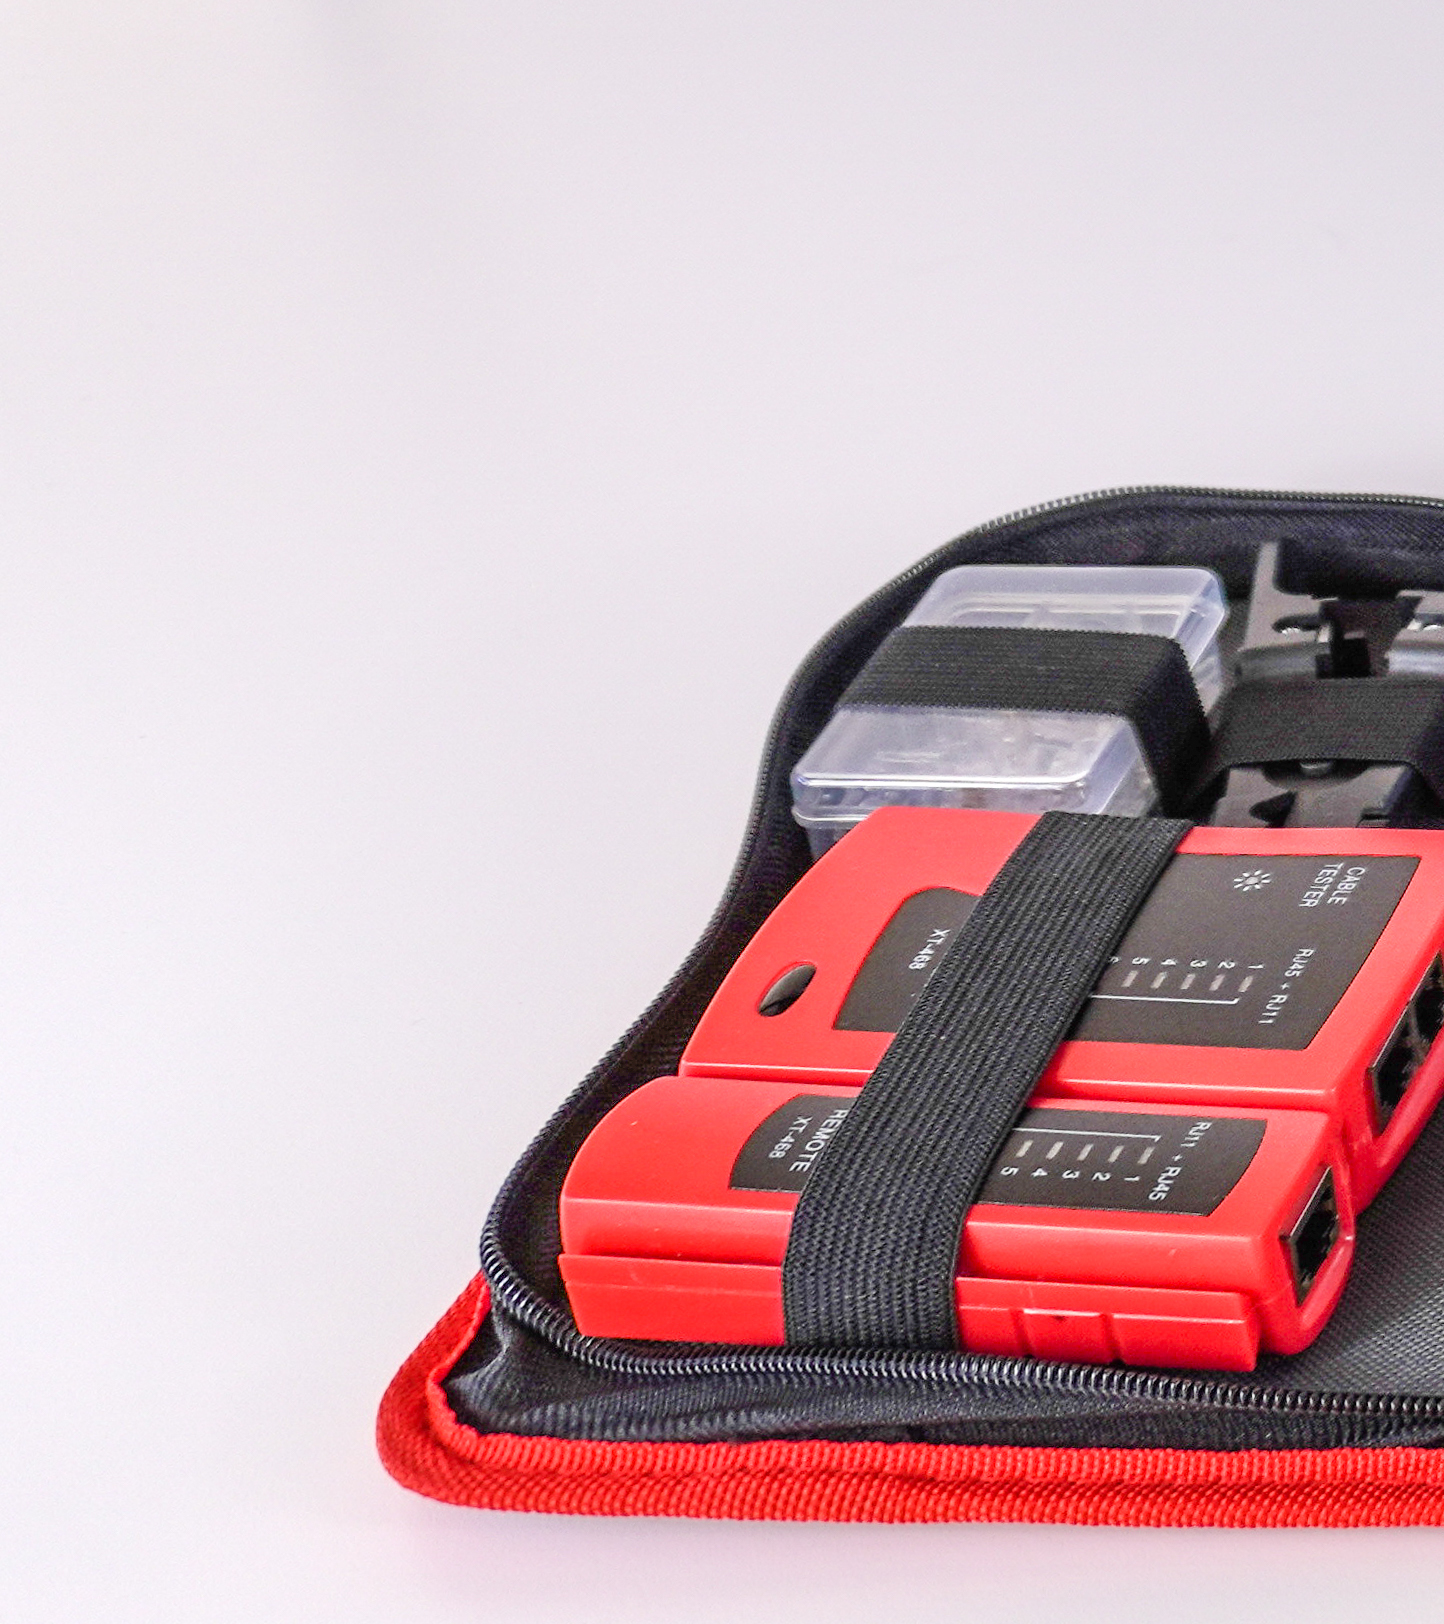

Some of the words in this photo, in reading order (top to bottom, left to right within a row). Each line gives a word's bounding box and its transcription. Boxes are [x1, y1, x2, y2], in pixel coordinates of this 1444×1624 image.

[1299, 862, 1345, 908] TESTER
[1327, 866, 1366, 906] CABLE
[908, 928, 950, 970] XT-468
[1132, 956, 1150, 966] 5
[1161, 958, 1177, 967] 4
[1190, 959, 1208, 969] 3
[1218, 960, 1236, 970] 2
[1284, 947, 1315, 978] RJ45
[1257, 994, 1289, 1025] RJ11
[768, 1115, 813, 1159] XT-468
[789, 1108, 850, 1172] REMOTE
[1181, 1121, 1213, 1148] RJ11
[1000, 1166, 1019, 1176] 5
[1031, 1167, 1048, 1178] 4
[1062, 1169, 1080, 1180] 3
[1092, 1172, 1111, 1182] 2
[1124, 1175, 1140, 1183] 1
[1148, 1165, 1183, 1202] RJ45
